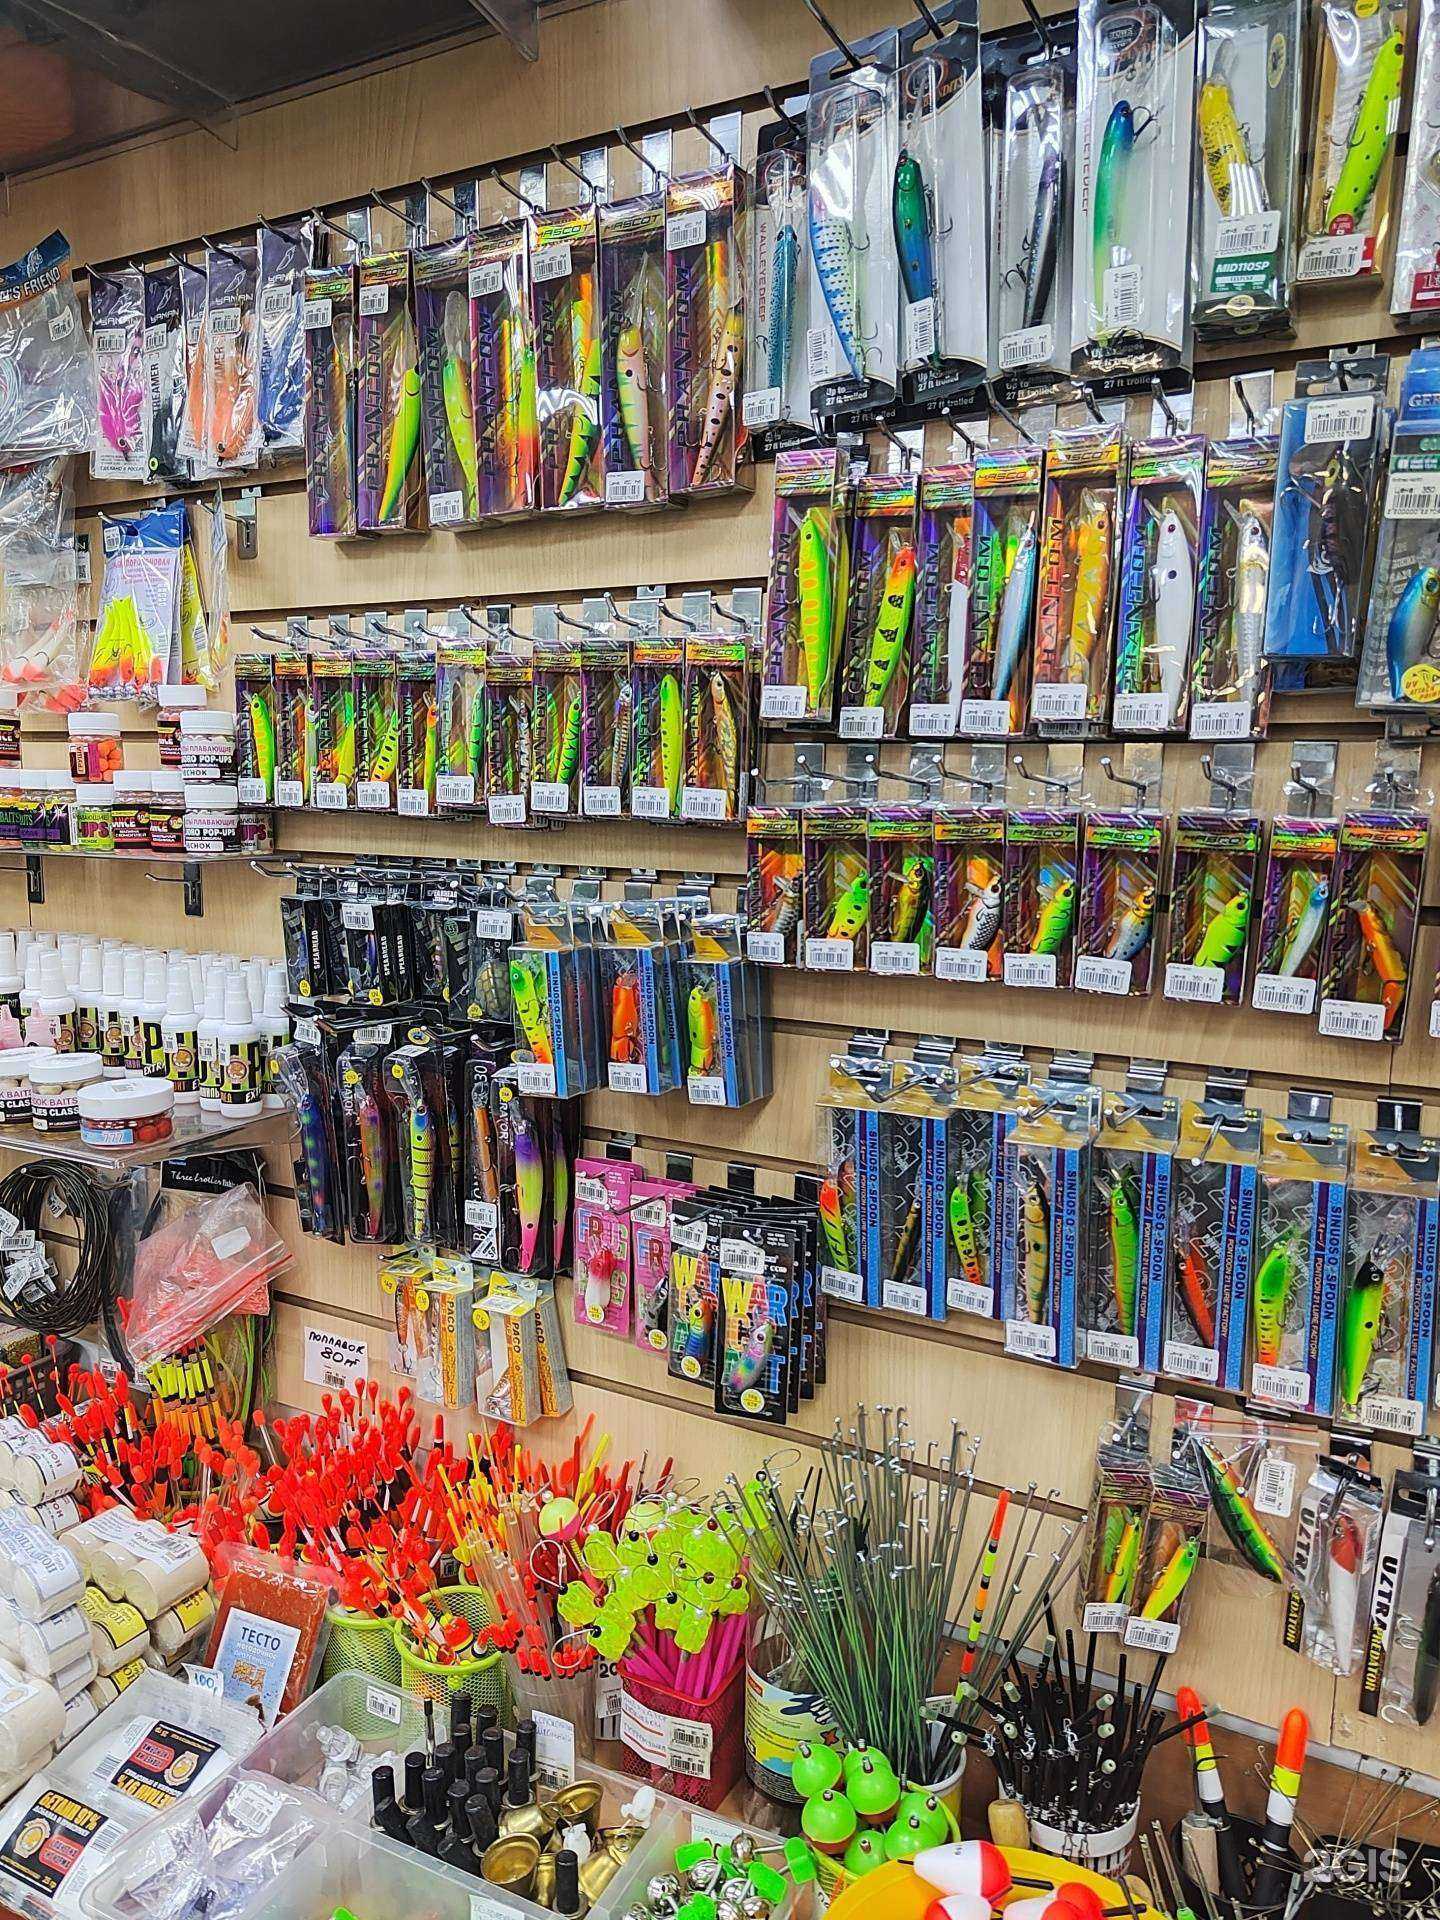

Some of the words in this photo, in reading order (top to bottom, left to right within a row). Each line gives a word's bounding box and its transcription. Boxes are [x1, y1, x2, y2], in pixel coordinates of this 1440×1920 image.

[24, 267, 61, 294] FRIEND
[363, 267, 406, 280] MASCOT
[416, 256, 467, 275] MASCOT
[479, 313, 496, 476] PHANTOM
[825, 396, 835, 405] 27
[1104, 379, 1115, 389] 27
[365, 334, 383, 491] PHANTOM
[427, 327, 447, 487] PHANTOM
[764, 443, 772, 451] 27
[534, 686, 547, 782] HANTOM
[688, 674, 700, 785] HANTOM
[199, 755, 233, 764] POP-UPS
[202, 828, 236, 837] POP-UPS
[940, 827, 1000, 837] MASCOT
[1013, 827, 1076, 838] MASCOT
[1346, 833, 1424, 845] MASCOT
[311, 929, 321, 970] SPEARHEAD
[380, 935, 390, 976] SPEARHEAD
[397, 934, 405, 975] SPEARHEAD
[553, 970, 562, 1012] SINUOSO
[644, 965, 653, 1011] SINUOSO
[722, 979, 730, 1024] SINUOSO
[556, 1018, 565, 1051] SPOON
[648, 1014, 656, 1045] SPOON
[724, 1027, 734, 1058] SPOON
[50, 1097, 78, 1107] BAITS
[103, 1132, 125, 1144] 777
[869, 1130, 878, 1184] SINUOSO
[935, 1140, 945, 1192] SINUOSO
[869, 1189, 878, 1228] SPOON
[935, 1198, 944, 1239] SPOON
[1065, 1170, 1077, 1226] SINUOSO
[1155, 1174, 1168, 1231] SINUOSO
[1241, 1189, 1253, 1247] SINUOSO
[1064, 1234, 1075, 1277] SPOON
[1327, 1206, 1342, 1266] SINUOSO
[1425, 1223, 1436, 1283] SINUOSO
[1152, 1238, 1164, 1282] SPOON
[1234, 1254, 1247, 1300] SPOON
[447, 1301, 455, 1333] PACO
[721, 1274, 788, 1327] WAR
[1323, 1275, 1338, 1320] SPOON
[1421, 1292, 1434, 1338] SPOON
[308, 1331, 365, 1354] ПОПЛАВОК
[512, 1322, 521, 1354] PACO
[534, 1313, 545, 1344] PACO
[321, 1347, 343, 1363] 80
[241, 1626, 281, 1651] ТЕСТО
[1365, 1626, 1384, 1692] PREDATOR
[38, 1791, 82, 1822] БЕТАИН
